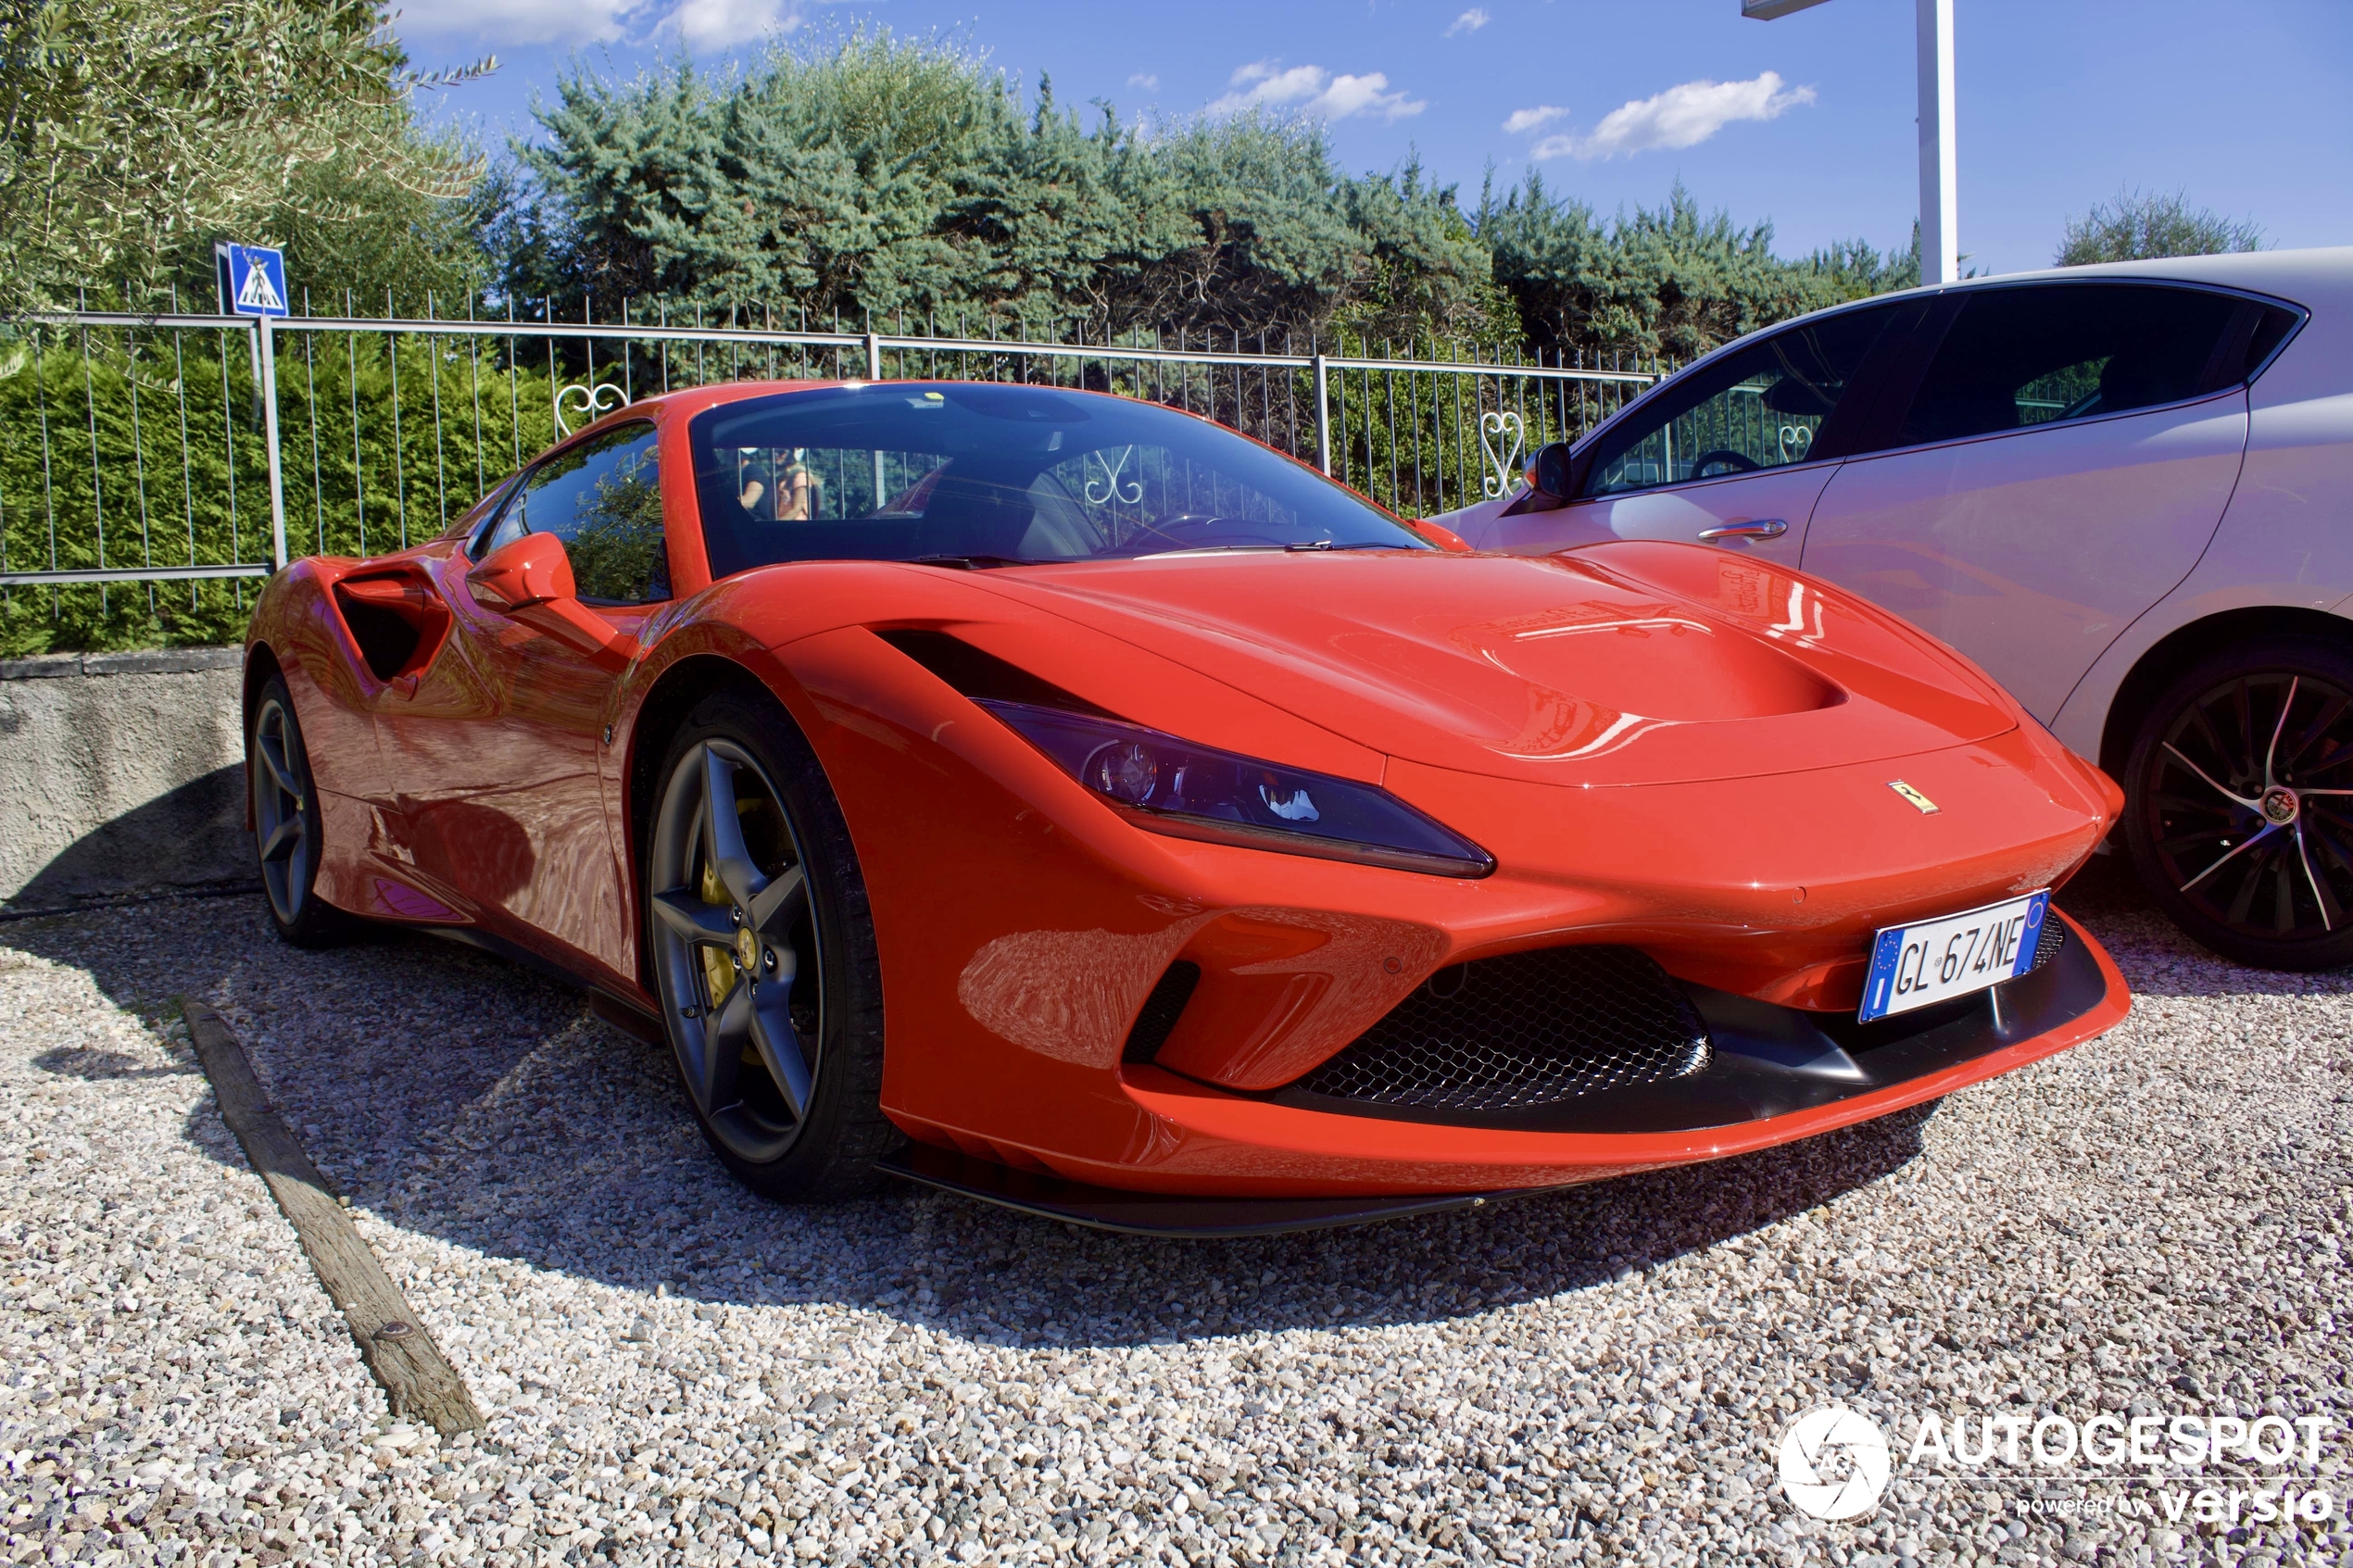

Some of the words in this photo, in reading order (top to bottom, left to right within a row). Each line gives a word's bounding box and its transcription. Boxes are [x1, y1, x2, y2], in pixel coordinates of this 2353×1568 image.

[1896, 940, 1929, 995] GL
[1940, 915, 2026, 984] 674NE
[1872, 978, 1885, 1010] I
